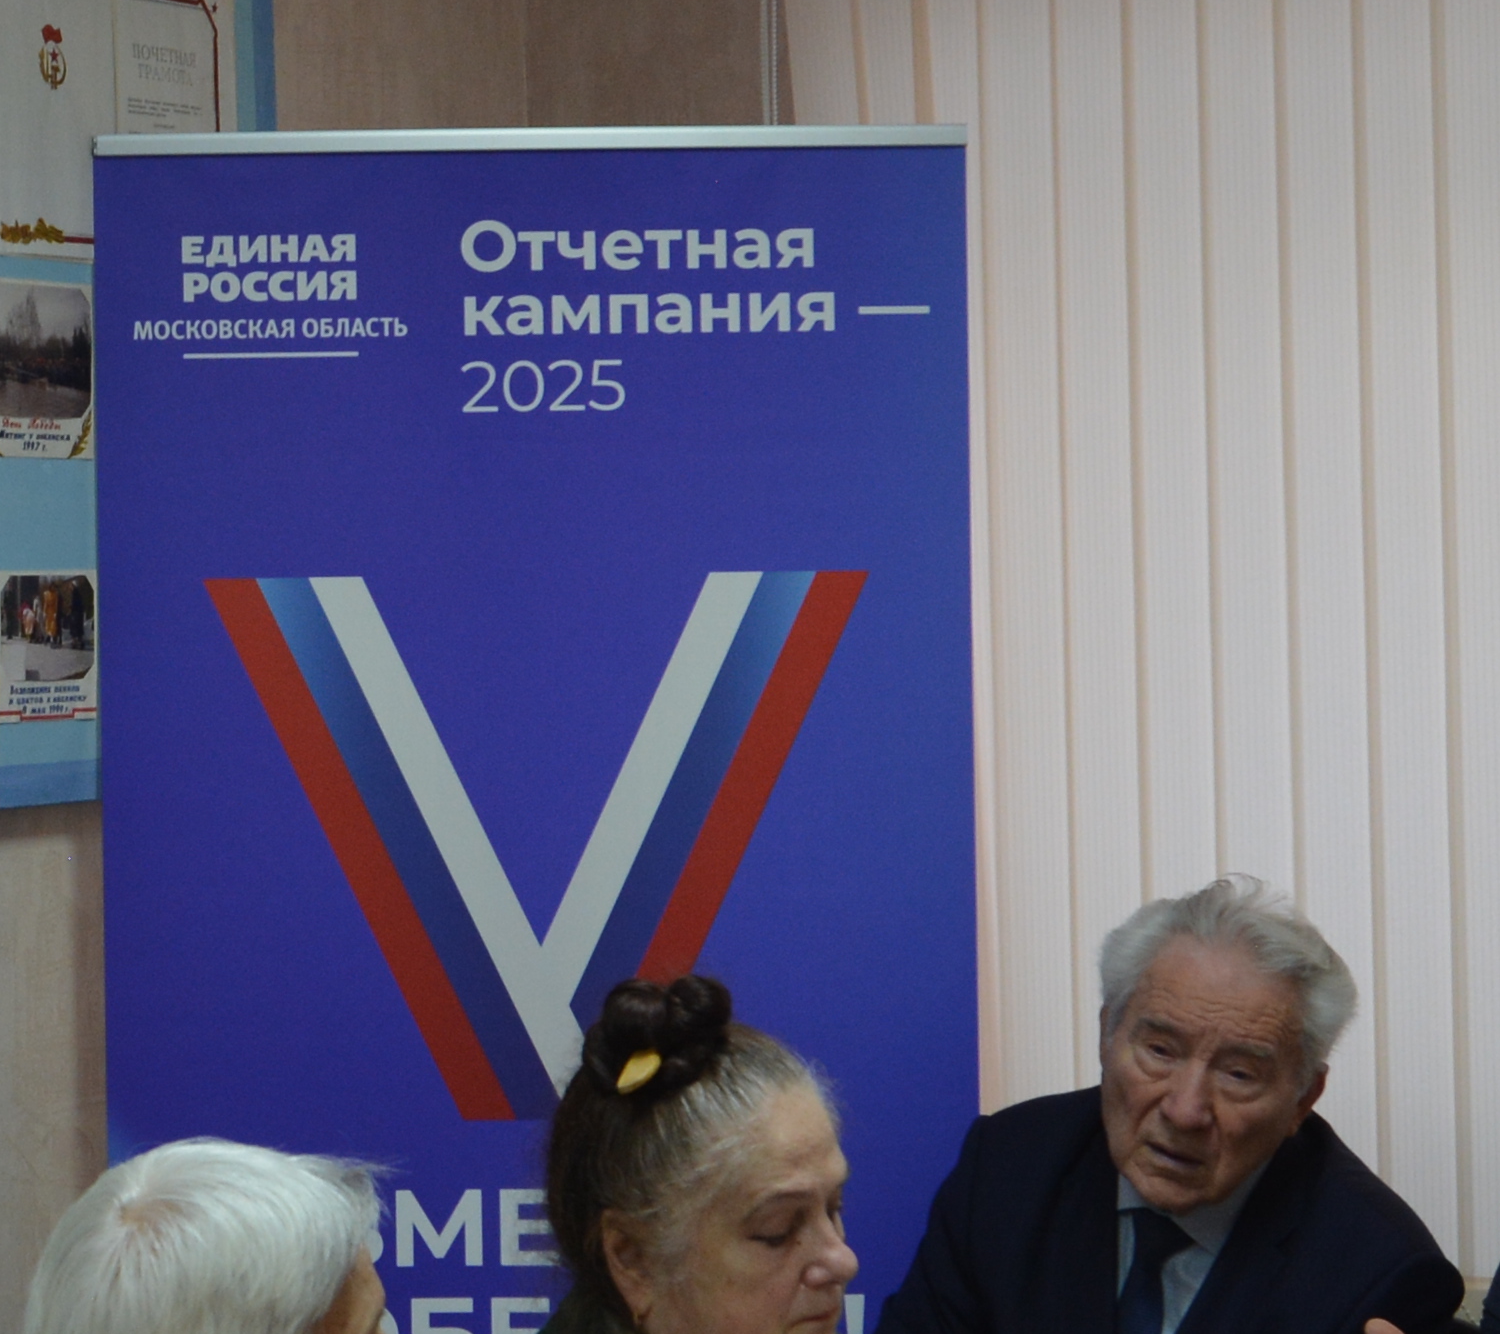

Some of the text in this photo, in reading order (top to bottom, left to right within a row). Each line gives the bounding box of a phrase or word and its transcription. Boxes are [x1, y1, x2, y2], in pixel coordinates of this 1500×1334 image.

[132, 43, 196, 68] ПОЧЕТНАЯ
[138, 63, 193, 88] ГРАМОТА
[180, 233, 358, 267] ЕДИНАЯ
[460, 219, 817, 273] Отчетная
[182, 269, 358, 304] РОССИЯ
[133, 315, 409, 342] МОСКОВСКАЯ ОБЛАСТЬ
[463, 290, 838, 337] кампания
[460, 359, 627, 414] 2025
